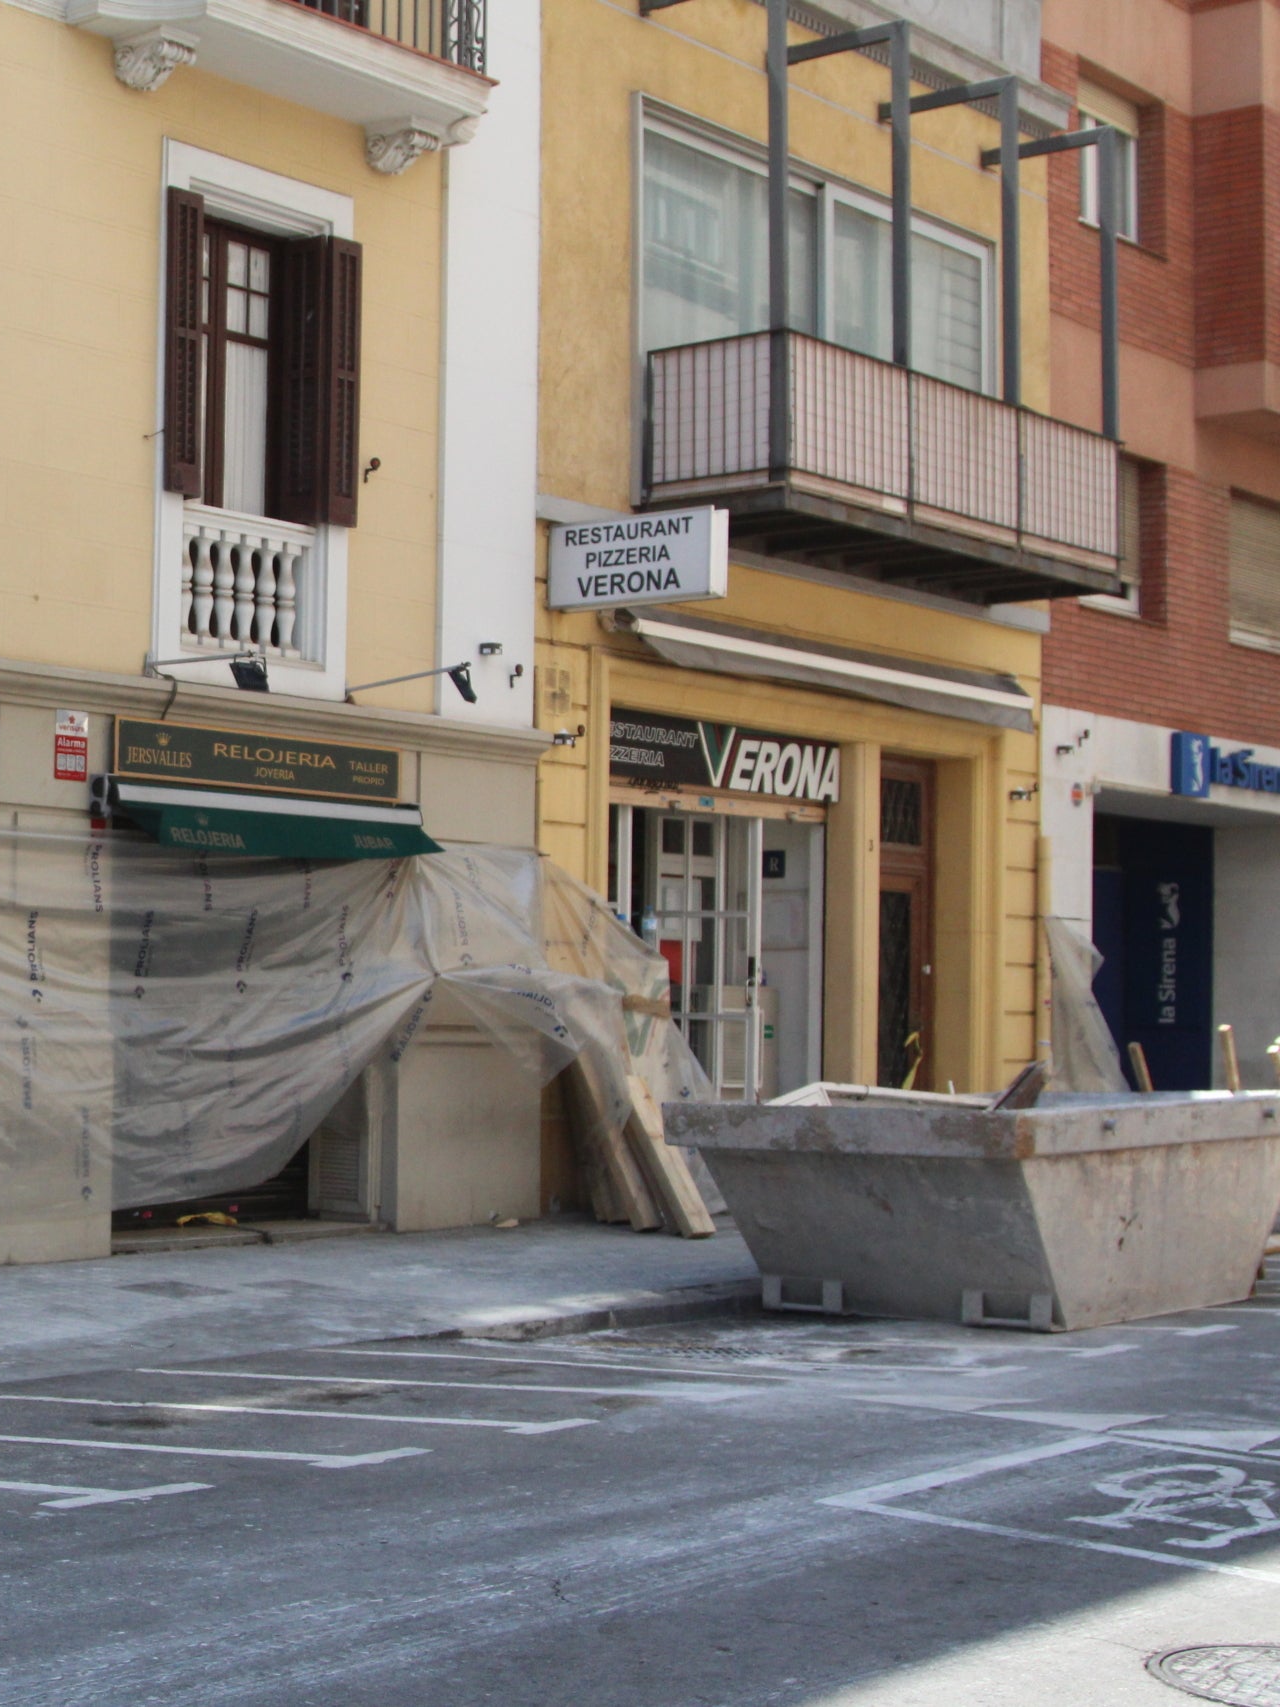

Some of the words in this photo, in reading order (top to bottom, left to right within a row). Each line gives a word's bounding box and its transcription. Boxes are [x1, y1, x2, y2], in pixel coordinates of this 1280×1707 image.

[565, 516, 693, 547] RESTAURANT
[586, 544, 670, 569] PIZZERIA
[578, 568, 680, 598] VERONA
[57, 736, 86, 748] Alarma
[126, 746, 192, 768] JERSVALLES
[213, 743, 336, 769] RELOJERIA
[349, 760, 388, 774] TALLER
[698, 721, 840, 802] VERONA
[255, 767, 295, 781] JOYERIA
[353, 776, 385, 786] PROPIO
[170, 827, 246, 849] RELOJERIA
[27, 911, 39, 982] PROLIANS
[1158, 937, 1176, 1002] Sirena
[1158, 1006, 1176, 1024] la
